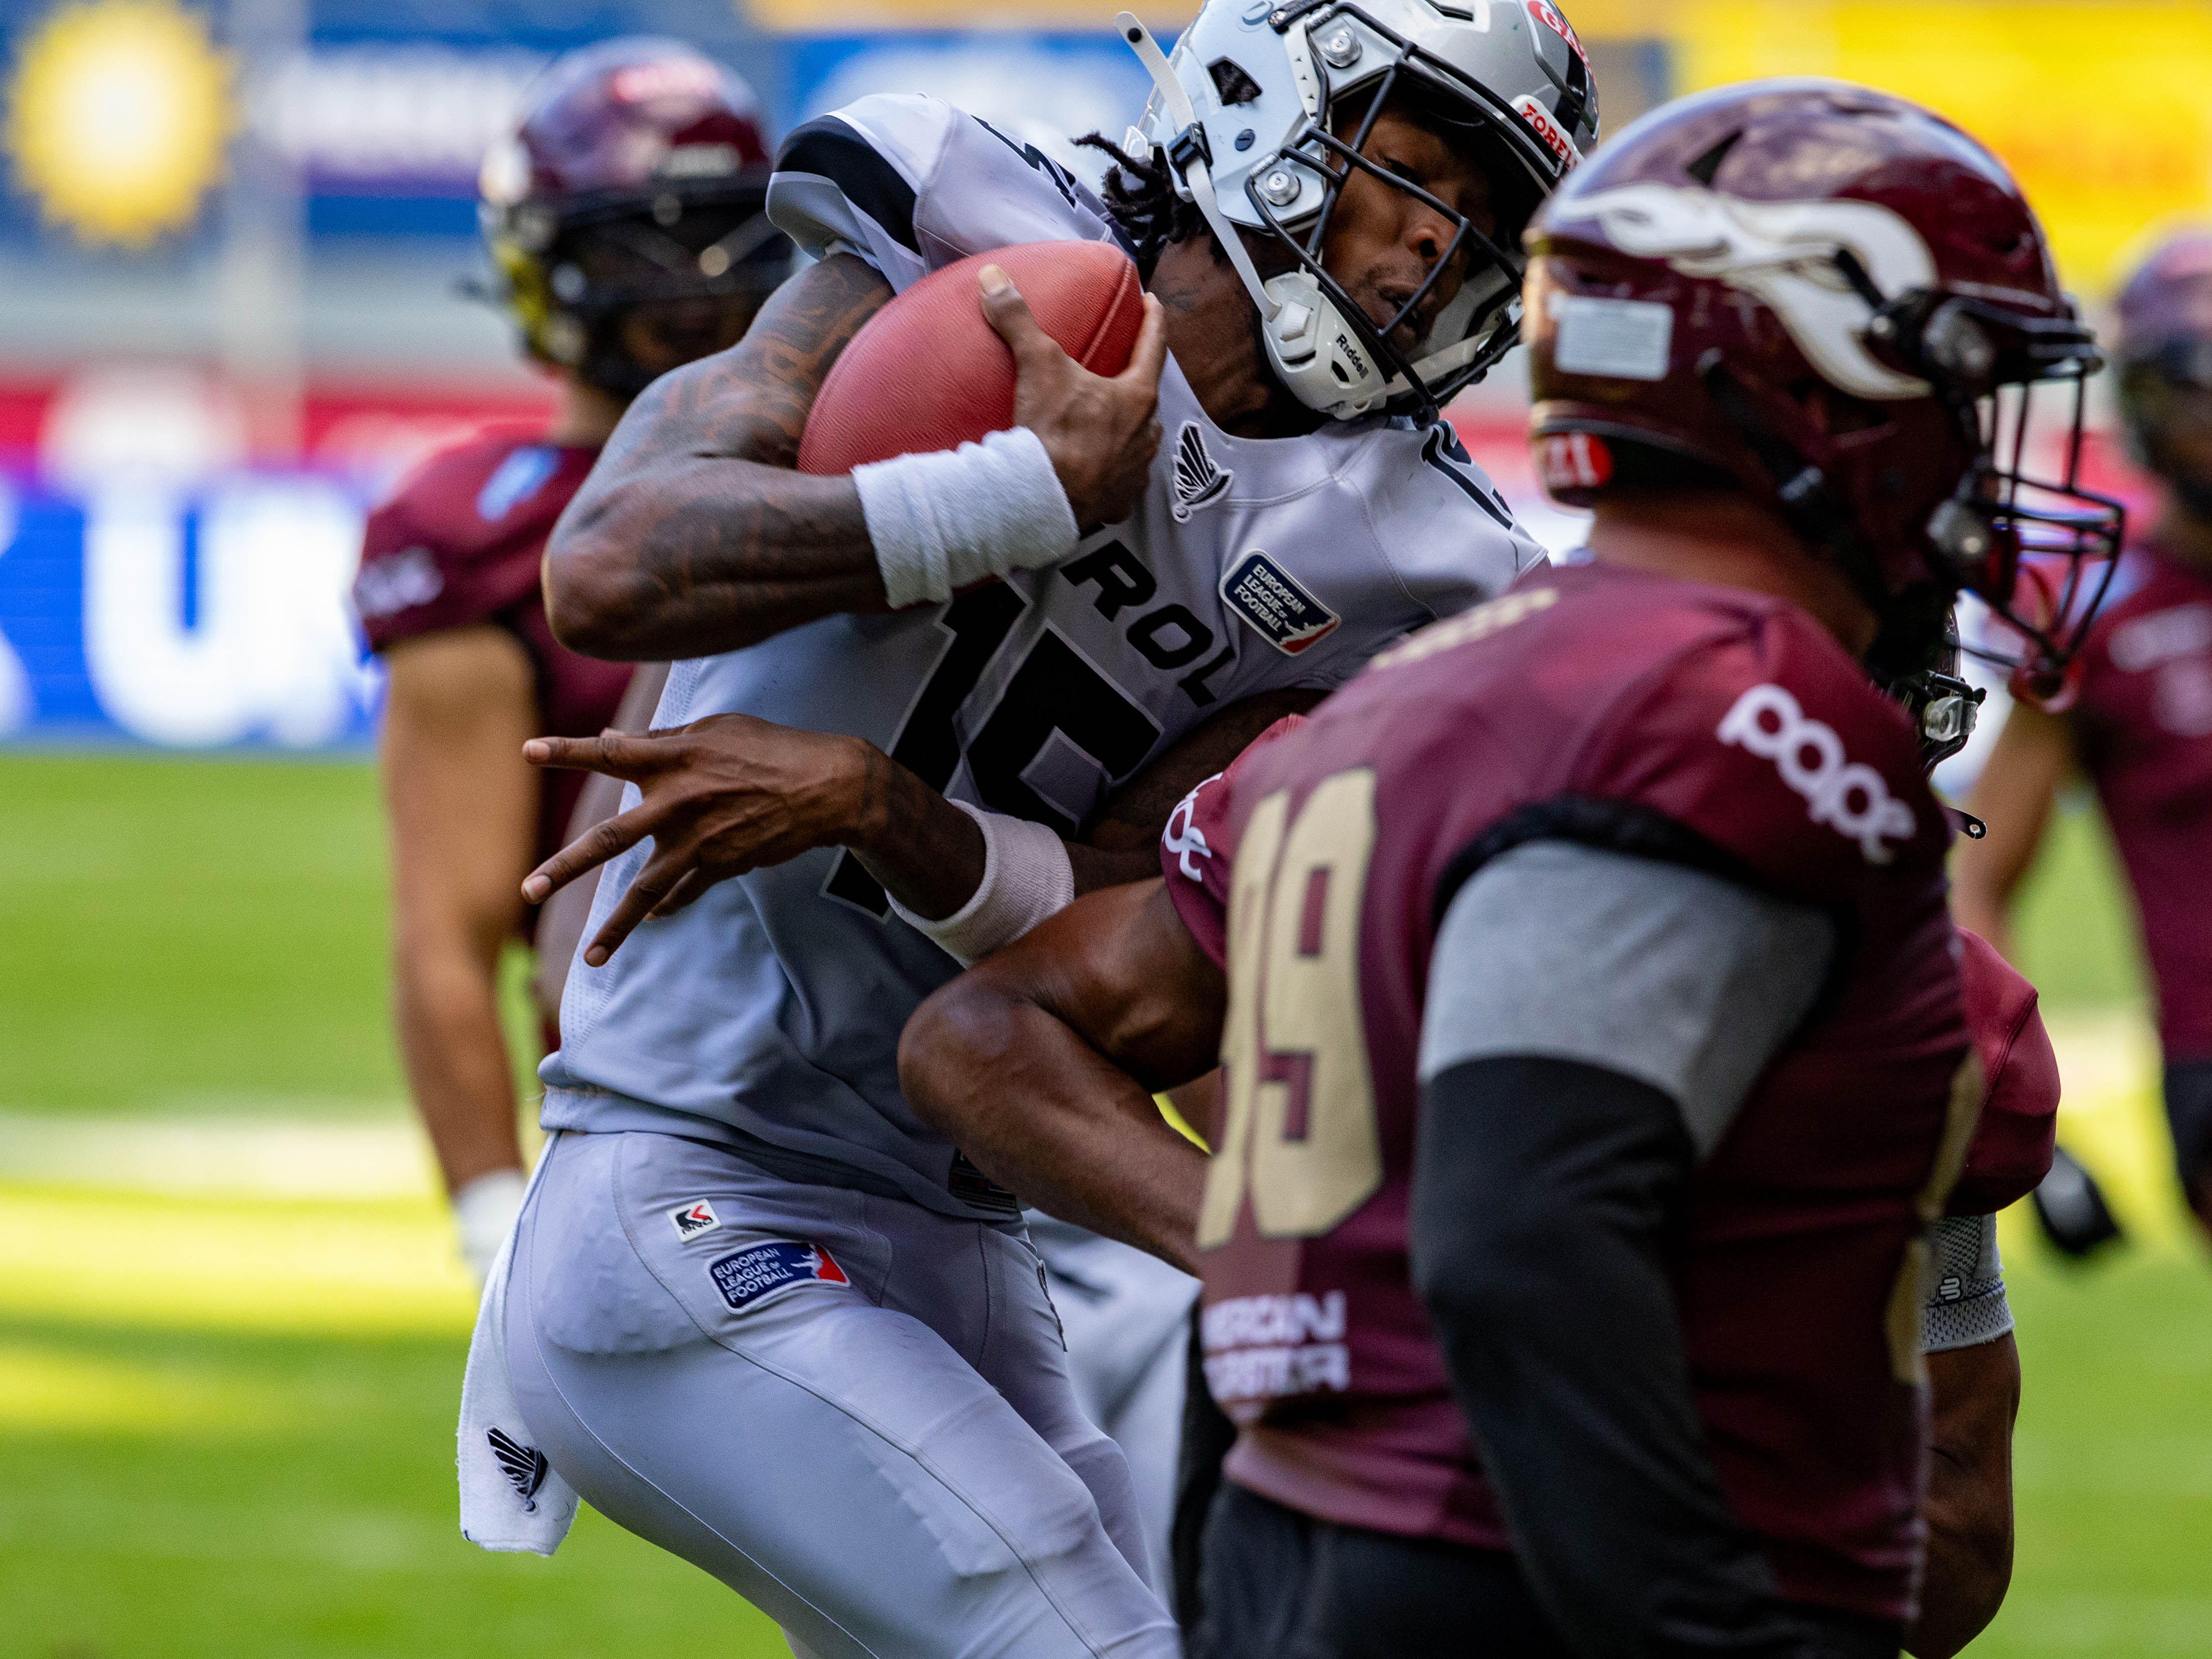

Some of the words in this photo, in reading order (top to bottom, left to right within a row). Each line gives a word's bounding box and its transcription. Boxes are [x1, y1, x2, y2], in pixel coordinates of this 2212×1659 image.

[1335, 333, 1369, 379] Riddell
[1234, 584, 1282, 632] FOOTBALL
[1243, 574, 1284, 613] LEAGUE
[1252, 563, 1306, 615] EUROPEAN
[1059, 539, 1237, 707] ROL
[712, 1248, 781, 1279] EUROPEAN
[720, 1262, 771, 1291] LEAGUE
[727, 1267, 794, 1303] FOOTBALL
